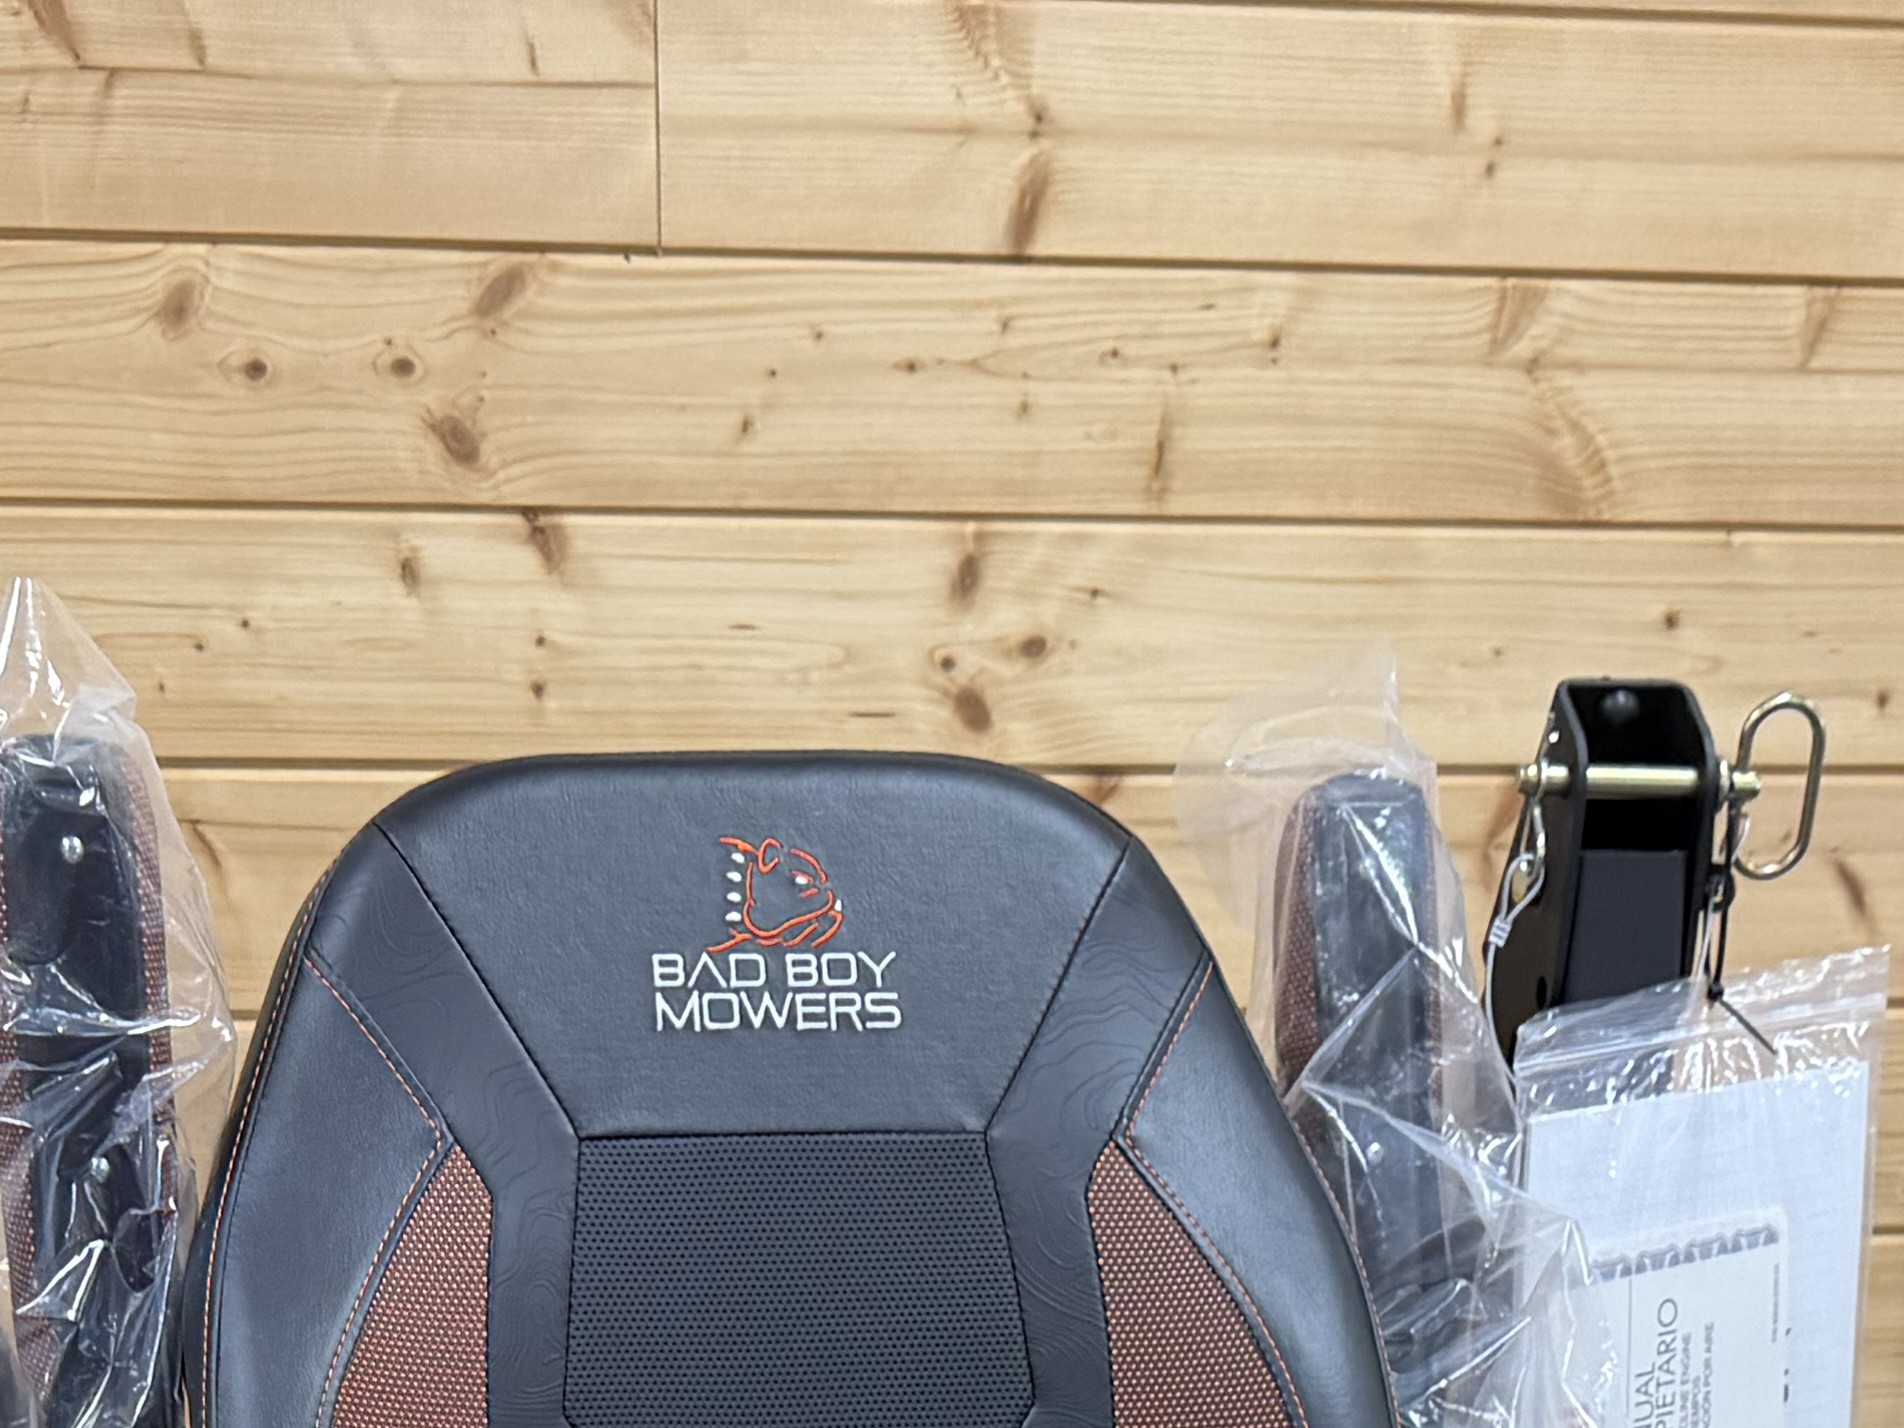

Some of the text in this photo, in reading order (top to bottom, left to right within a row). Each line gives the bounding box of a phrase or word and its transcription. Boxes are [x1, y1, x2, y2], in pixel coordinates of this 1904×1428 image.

[652, 951, 896, 989] BAD BOY
[655, 990, 902, 1032] MOWERS
